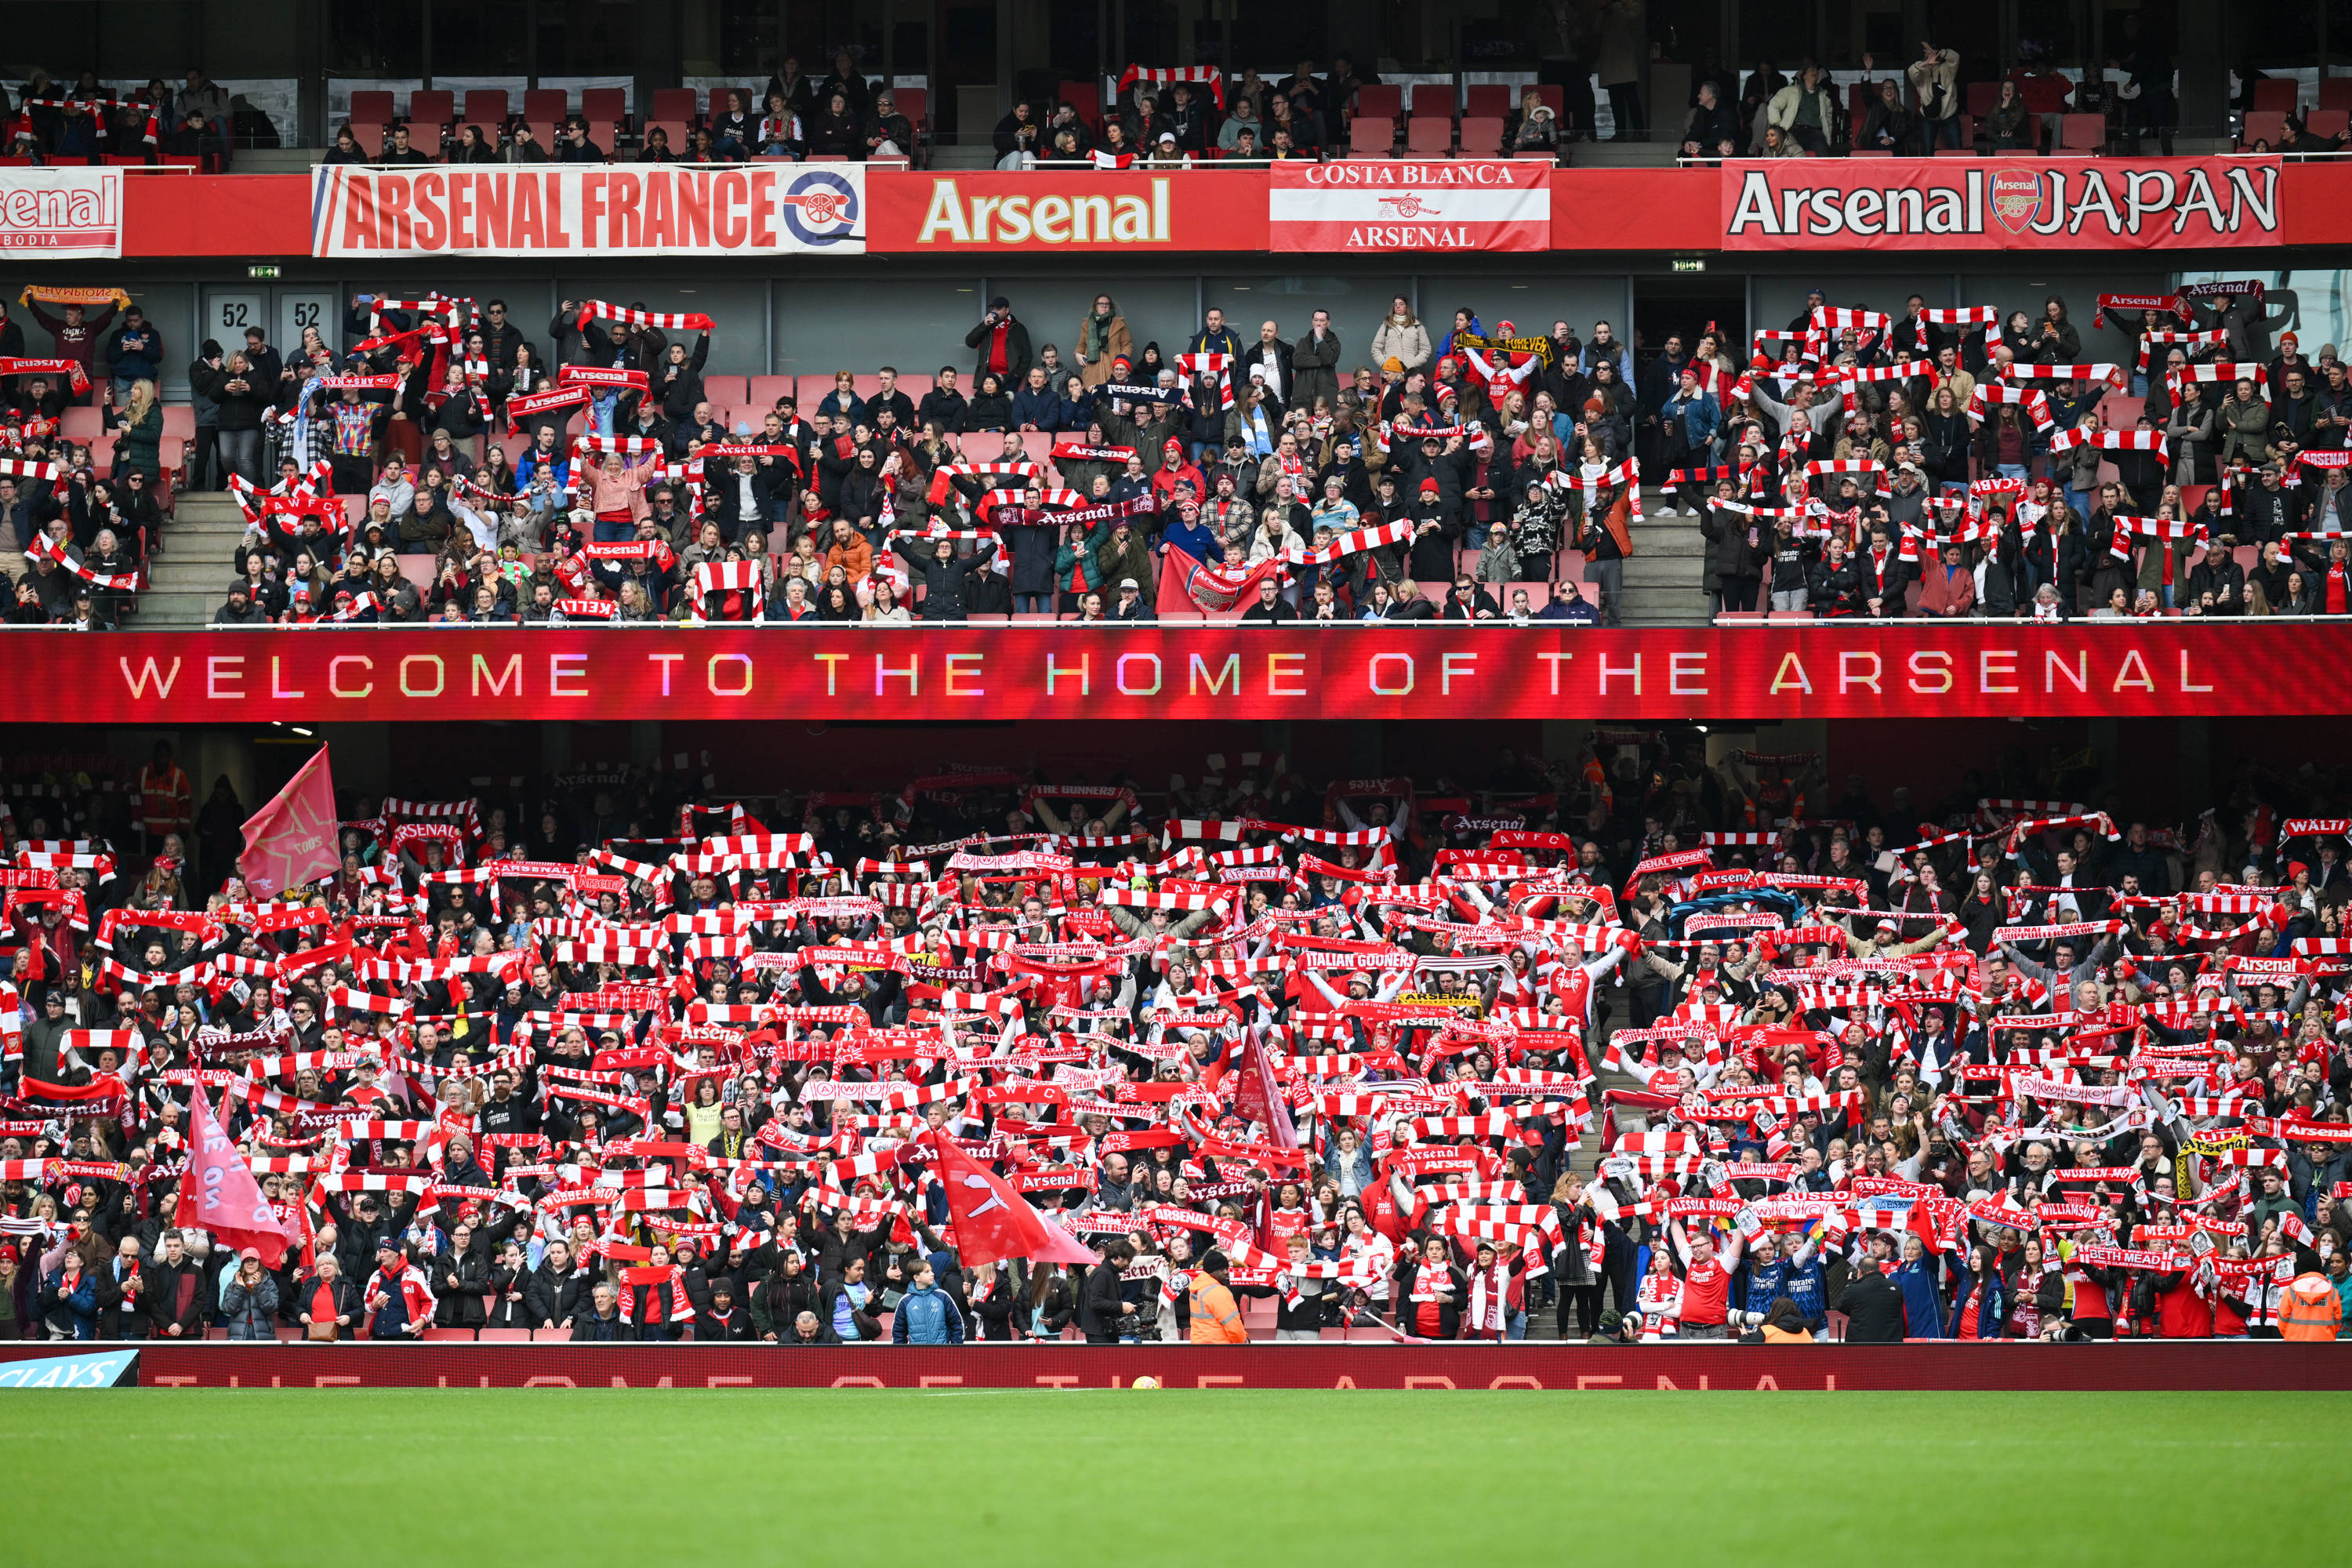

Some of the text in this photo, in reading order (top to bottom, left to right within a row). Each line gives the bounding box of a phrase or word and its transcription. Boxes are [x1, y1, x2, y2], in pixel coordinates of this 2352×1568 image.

[1305, 165, 1515, 184] COSTA BLANCA
[1995, 180, 2036, 191] Arsenal
[1728, 166, 2280, 237] Arsenal JAPAN
[343, 172, 776, 250] ARSENAL FRANCE
[917, 178, 1172, 244] Arsenal
[1345, 226, 1475, 247] ARSENAL
[2190, 281, 2249, 297] Arsenal
[2111, 295, 2161, 307] Arsenal
[223, 303, 249, 328] 52
[294, 303, 320, 328] 52
[1505, 338, 1548, 353] FOREVER
[13, 359, 65, 371] Arsenal
[568, 369, 629, 382] Arsenal
[1108, 384, 1169, 398] Arsenal
[524, 390, 583, 410] Arsenal
[715, 444, 768, 455] Arsenal
[1066, 445, 1133, 459] Arsenal
[2302, 452, 2350, 467] ARSENAL
[1037, 505, 1114, 525] Arsenal
[586, 543, 644, 555] Arsenal
[564, 599, 612, 615] KELLY
[120, 649, 2213, 698] WELCOME TO THE HOME OF THE ARSENAL
[2291, 819, 2345, 832] WÄLTI
[396, 823, 456, 847] ARSENAL
[502, 865, 572, 874] ARSENAL
[1225, 869, 1275, 880] Arsenal
[579, 877, 622, 891] Arsena
[1766, 873, 1820, 884] ARSENAL
[1526, 884, 1595, 897] ARSENAL
[354, 915, 405, 927] Arsenal
[1690, 920, 1748, 933] SUPPORTERS
[1998, 923, 2099, 936] ARSENAL WOMEN
[2002, 927, 2095, 942] SUPPORTERS CLUB
[814, 948, 887, 965] ARSENAL F.C.
[1307, 953, 1415, 968] ITALIAN GOONERS
[2238, 956, 2297, 972] Arsenal
[926, 1012, 980, 1022] ARENAL
[1106, 1007, 1129, 1017] CLUB
[1160, 1013, 1225, 1024] ZINSBERGER
[681, 1025, 744, 1042] Arsenal
[869, 1028, 921, 1039] MEAD
[1621, 1031, 1689, 1042] SUPPORTERS
[197, 1030, 280, 1052] Arsenal
[554, 1067, 615, 1083] KELLY
[1711, 1083, 1777, 1096] WILLIAMSON
[1385, 1102, 1442, 1112] LEGERS
[1685, 1106, 1748, 1119] RUSSO
[2285, 1125, 2352, 1138] Arsenal
[2180, 1137, 2249, 1153] Arsenal
[909, 1142, 1000, 1163] Arnal
[1402, 1146, 1460, 1161] Arsenal
[64, 1164, 120, 1178] Arsenal
[1425, 1160, 1475, 1170] Arsen
[1729, 1162, 1778, 1177] WILLIAMSON
[1022, 1172, 1078, 1188] Arsenal
[2060, 1168, 2136, 1181] WUBBEN-MOY
[466, 1185, 497, 1197] RUSSO
[544, 1188, 619, 1207] WUBBEN-MOY
[1781, 1191, 1849, 1202] RUSSO
[1670, 1200, 1740, 1214] ALESSIA RUSSO
[2039, 1205, 2100, 1221] WILLIAMSON
[654, 1216, 714, 1231] McCABE
[1155, 1207, 1233, 1232] ARSENAL F.C.
[1271, 1224, 1300, 1233] Emirates
[2143, 1225, 2187, 1236] MEAD
[2089, 1248, 2161, 1265] BETH MEAD
[2219, 1260, 2277, 1275] McCAB
[1788, 1278, 1816, 1287] mirates
